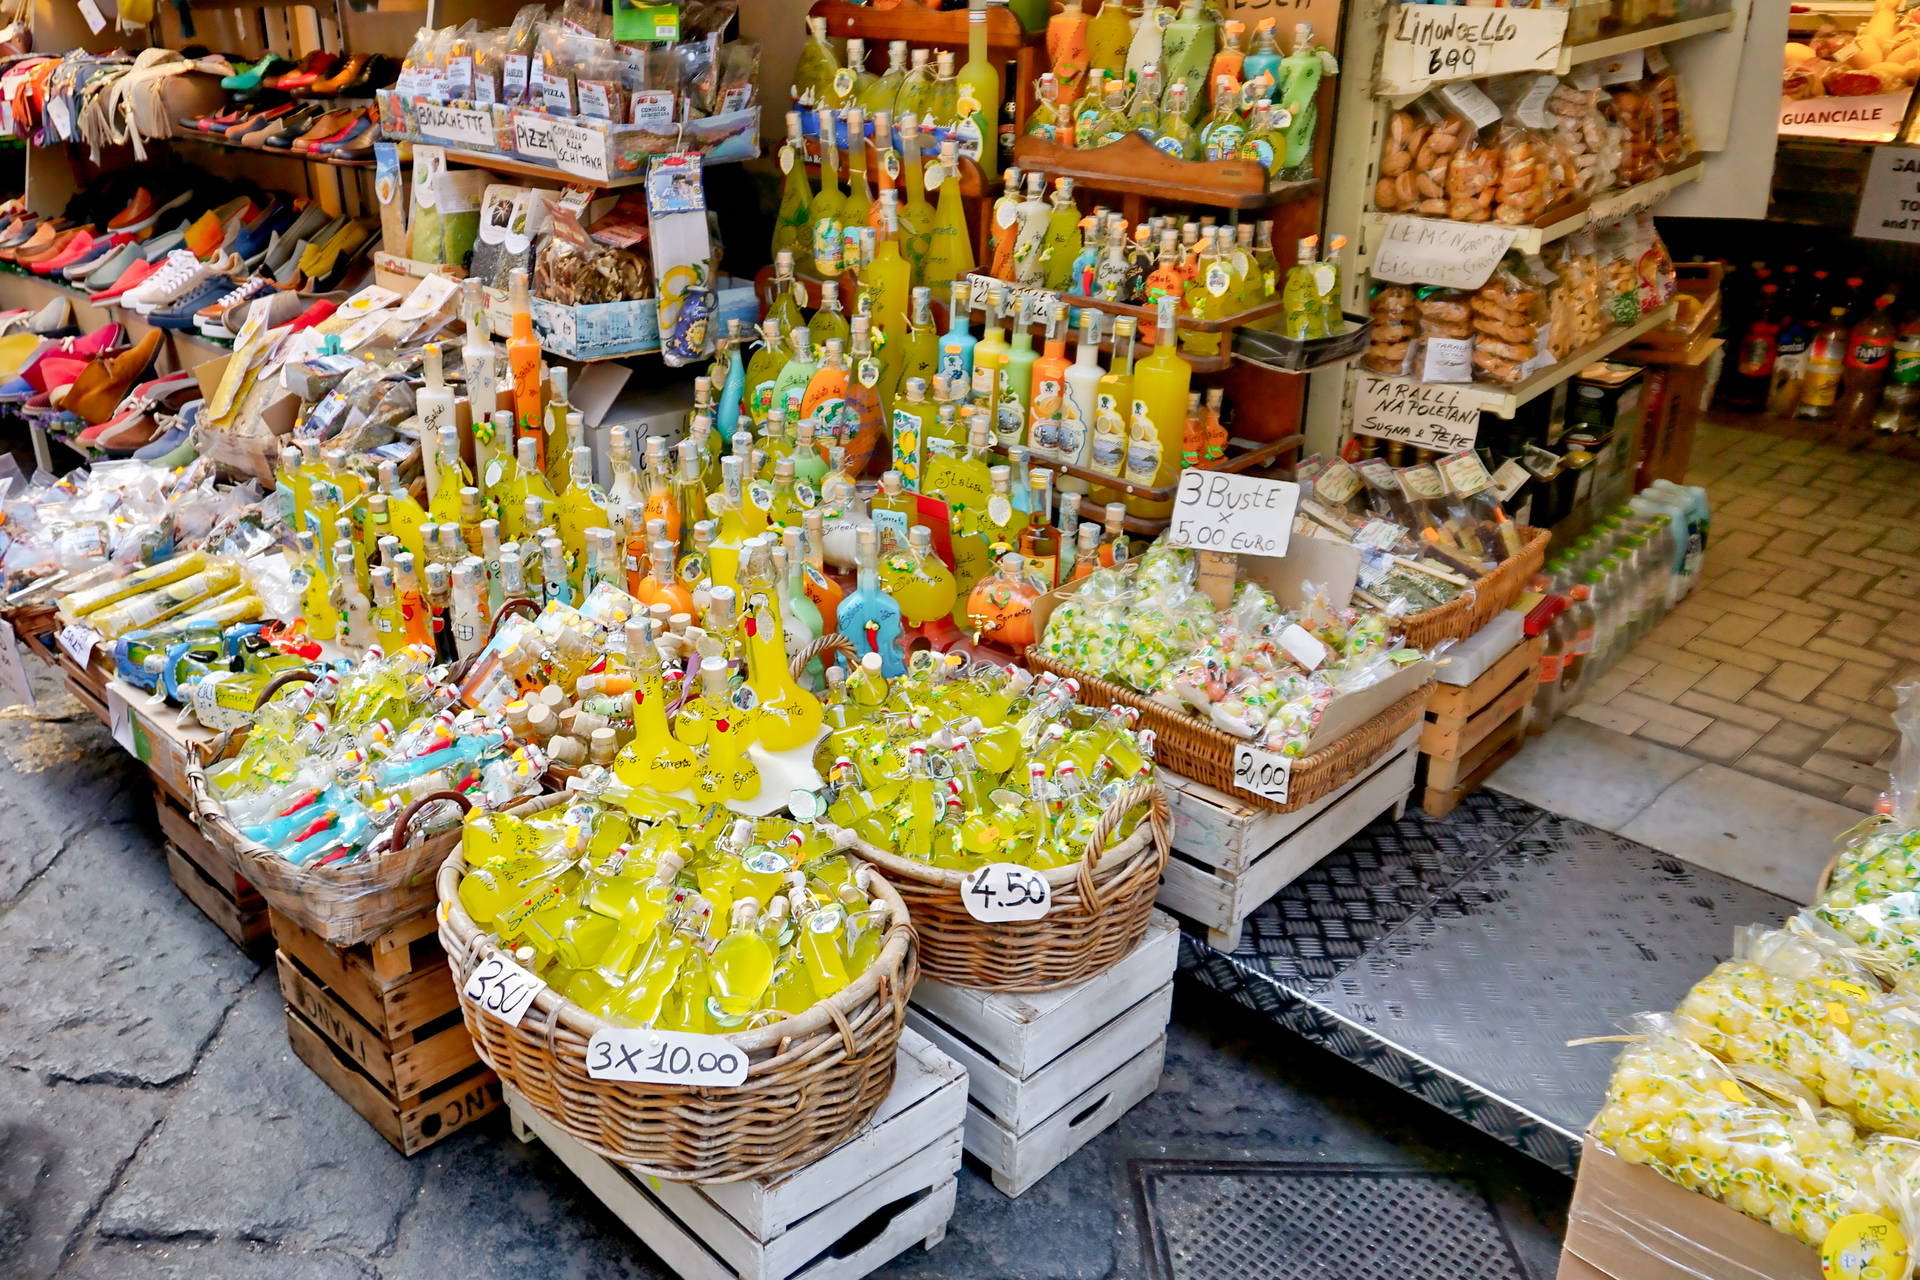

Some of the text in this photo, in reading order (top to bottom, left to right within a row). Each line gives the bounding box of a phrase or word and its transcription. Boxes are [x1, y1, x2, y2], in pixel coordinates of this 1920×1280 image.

[418, 106, 486, 135] BRUSCHETTE
[1782, 107, 1883, 126] GUANCIALE
[1389, 222, 1467, 249] LEMON
[1374, 399, 1481, 425] NAPOLETANI
[1180, 472, 1205, 506] 3
